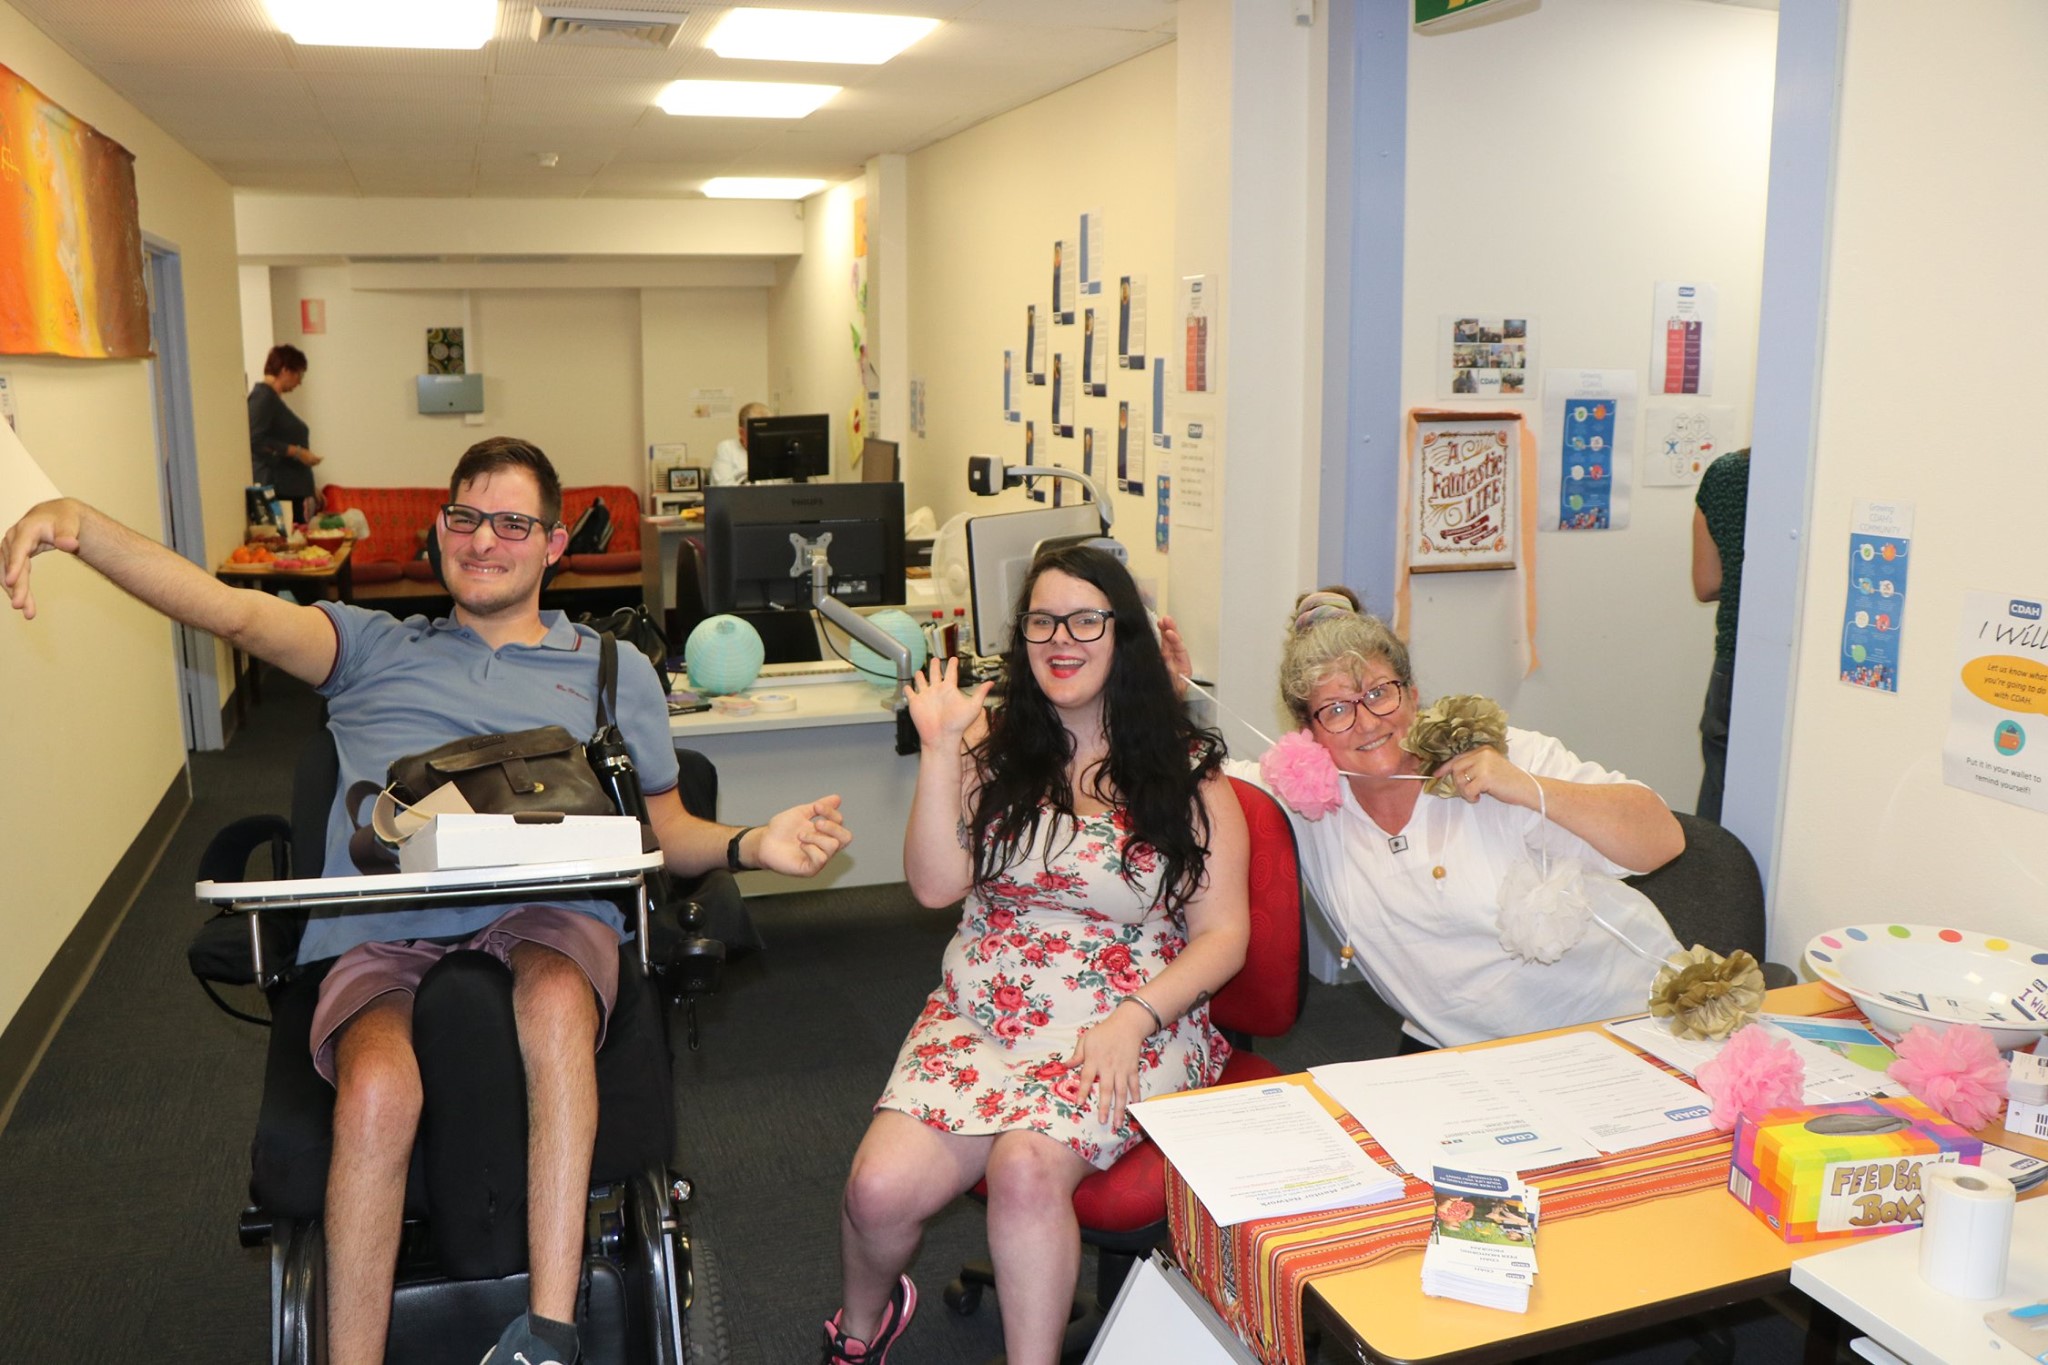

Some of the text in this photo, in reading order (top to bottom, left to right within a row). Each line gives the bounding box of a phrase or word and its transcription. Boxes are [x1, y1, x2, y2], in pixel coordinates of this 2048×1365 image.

[1444, 440, 1462, 466] A
[1428, 451, 1503, 504] Fantastic
[1465, 479, 1502, 523] LIFE
[1859, 523, 1902, 535] COMMUNITY
[2010, 604, 2041, 617] CDAH
[1979, 620, 1989, 640] I
[1986, 663, 1999, 672] Let
[2008, 668, 2029, 678] know
[2028, 672, 2048, 682] what
[1984, 677, 2047, 695] you're going to do
[1994, 691, 2009, 699] with
[1966, 757, 1978, 766] Put
[1993, 766, 2010, 774] your
[2010, 770, 2032, 781] wallet
[2033, 775, 2042, 783] to
[1975, 774, 1999, 786] remind
[2018, 988, 2033, 1002] I
[1669, 1108, 1709, 1121] CDAH
[1498, 1133, 1535, 1144] CDAH
[1305, 1188, 1338, 1199] Mentor
[1260, 1196, 1302, 1207] Network
